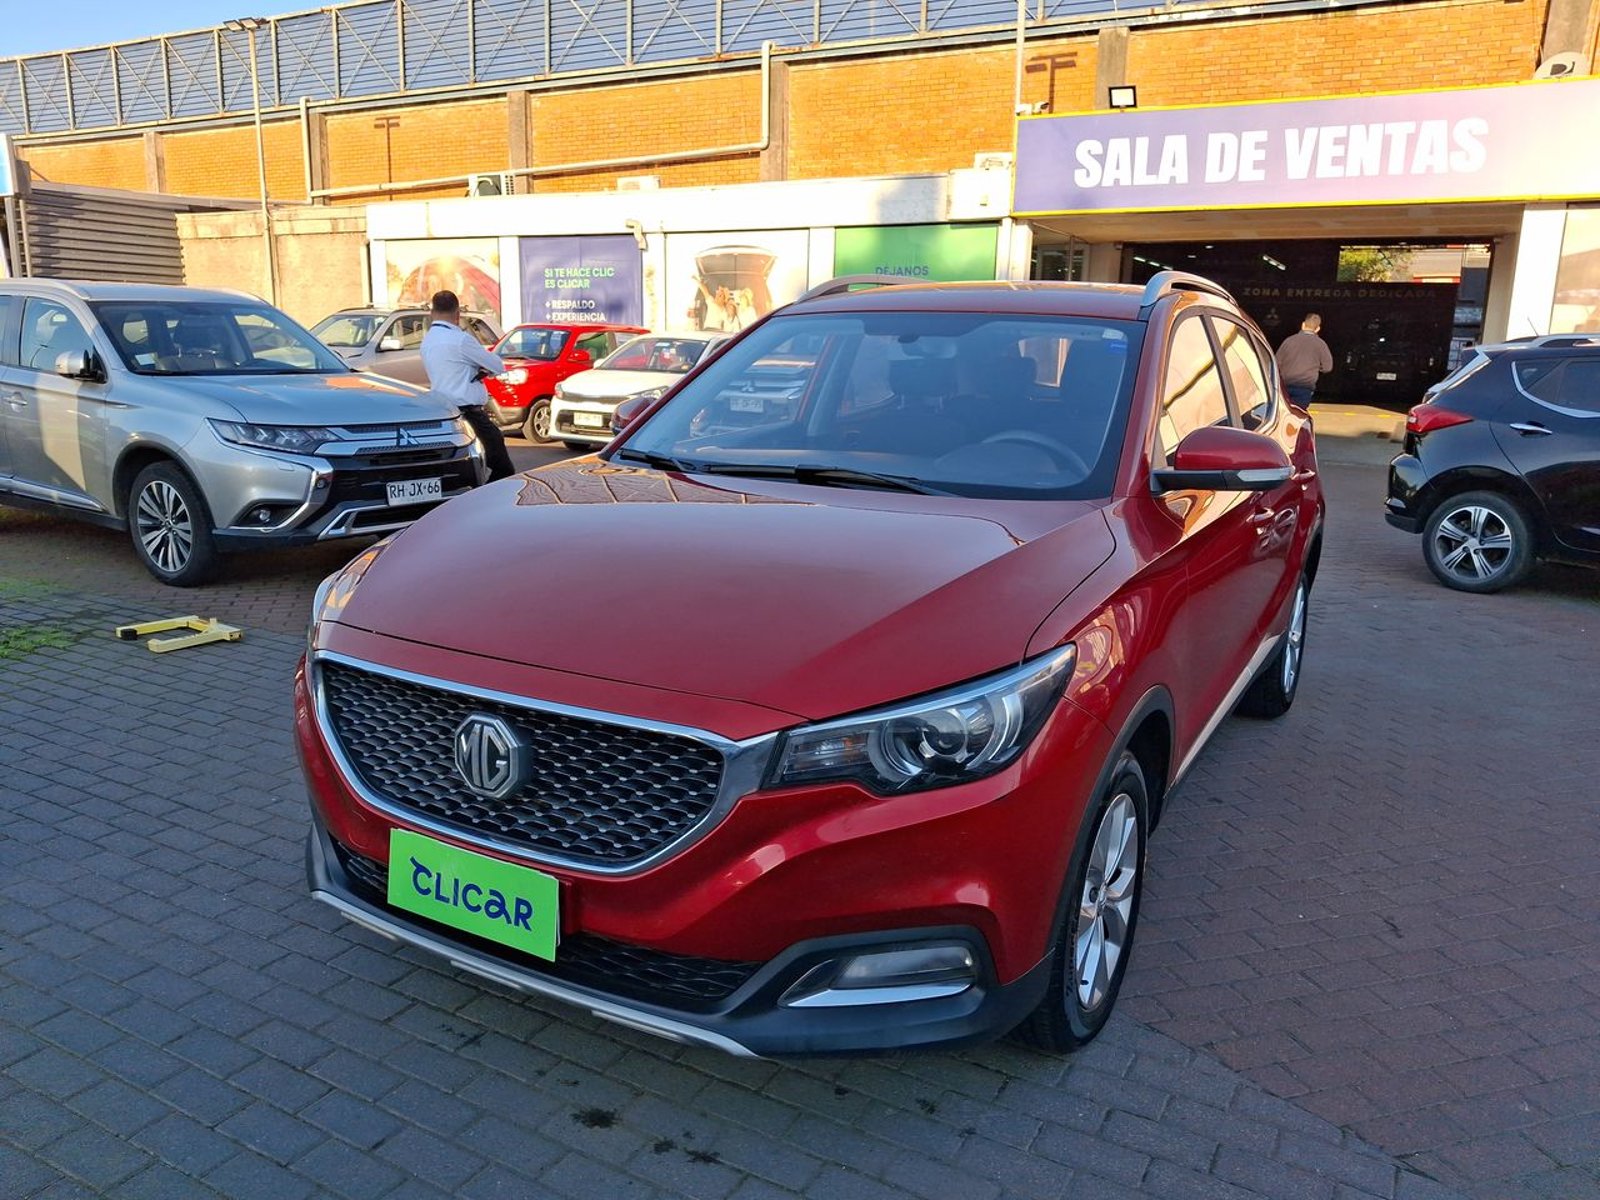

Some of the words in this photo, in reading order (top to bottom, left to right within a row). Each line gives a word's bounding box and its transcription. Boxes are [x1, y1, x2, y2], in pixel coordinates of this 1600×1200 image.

[1074, 134, 1189, 188] SALA
[1205, 130, 1269, 184] DE
[1285, 117, 1489, 180] VENTAS
[544, 268, 553, 278] SI
[555, 268, 565, 277] TE
[566, 267, 591, 277] HACE
[592, 267, 615, 277] CLIC
[544, 279, 556, 289] ES
[557, 279, 590, 289] CLICAR
[1242, 287, 1281, 296] ZONA
[552, 300, 595, 309] RESPALDO
[552, 312, 606, 321] EXPERIENCIA
[458, 723, 508, 790] MG
